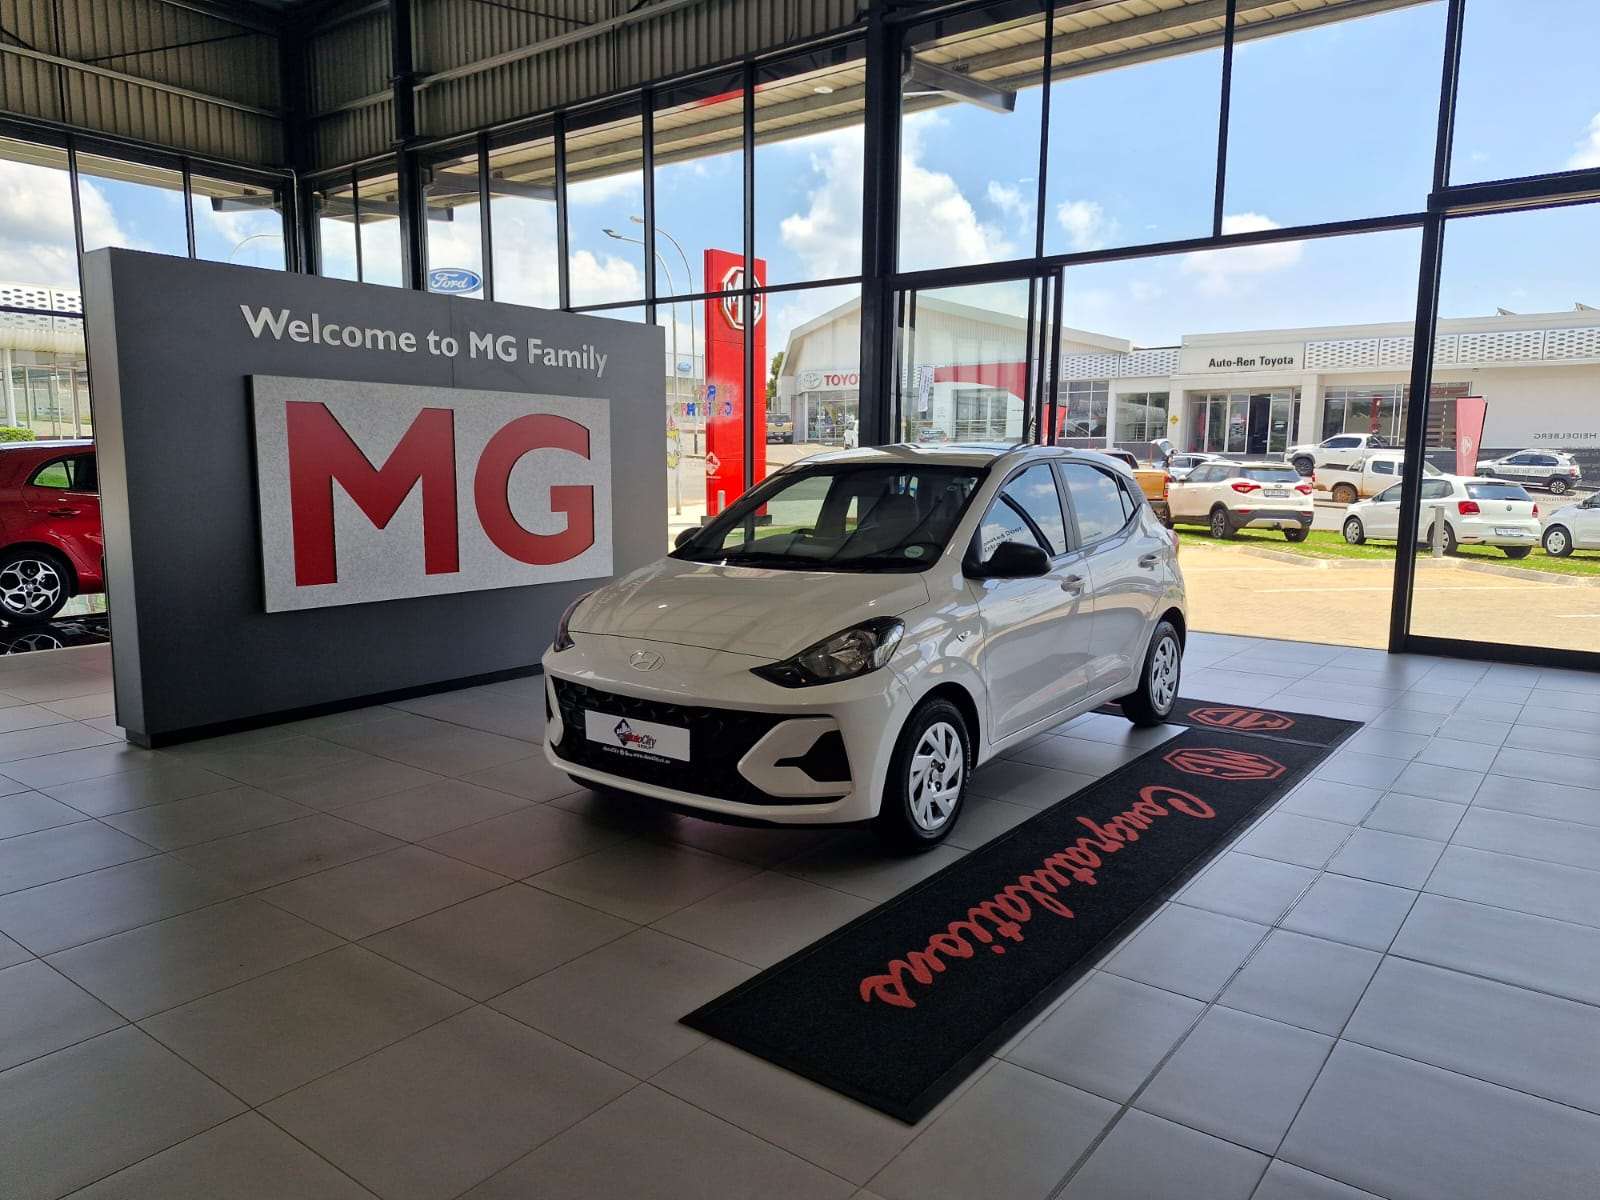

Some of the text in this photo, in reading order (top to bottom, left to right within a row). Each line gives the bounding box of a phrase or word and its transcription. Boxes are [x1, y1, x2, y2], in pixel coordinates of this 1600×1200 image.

[432, 273, 468, 288] Ford
[240, 304, 608, 378] Welcome to MG Family
[1208, 355, 1295, 368] Auto-Ren Toyota
[824, 373, 860, 386] TOYO
[286, 400, 595, 587] MG
[860, 786, 1216, 1008] Congratulations
